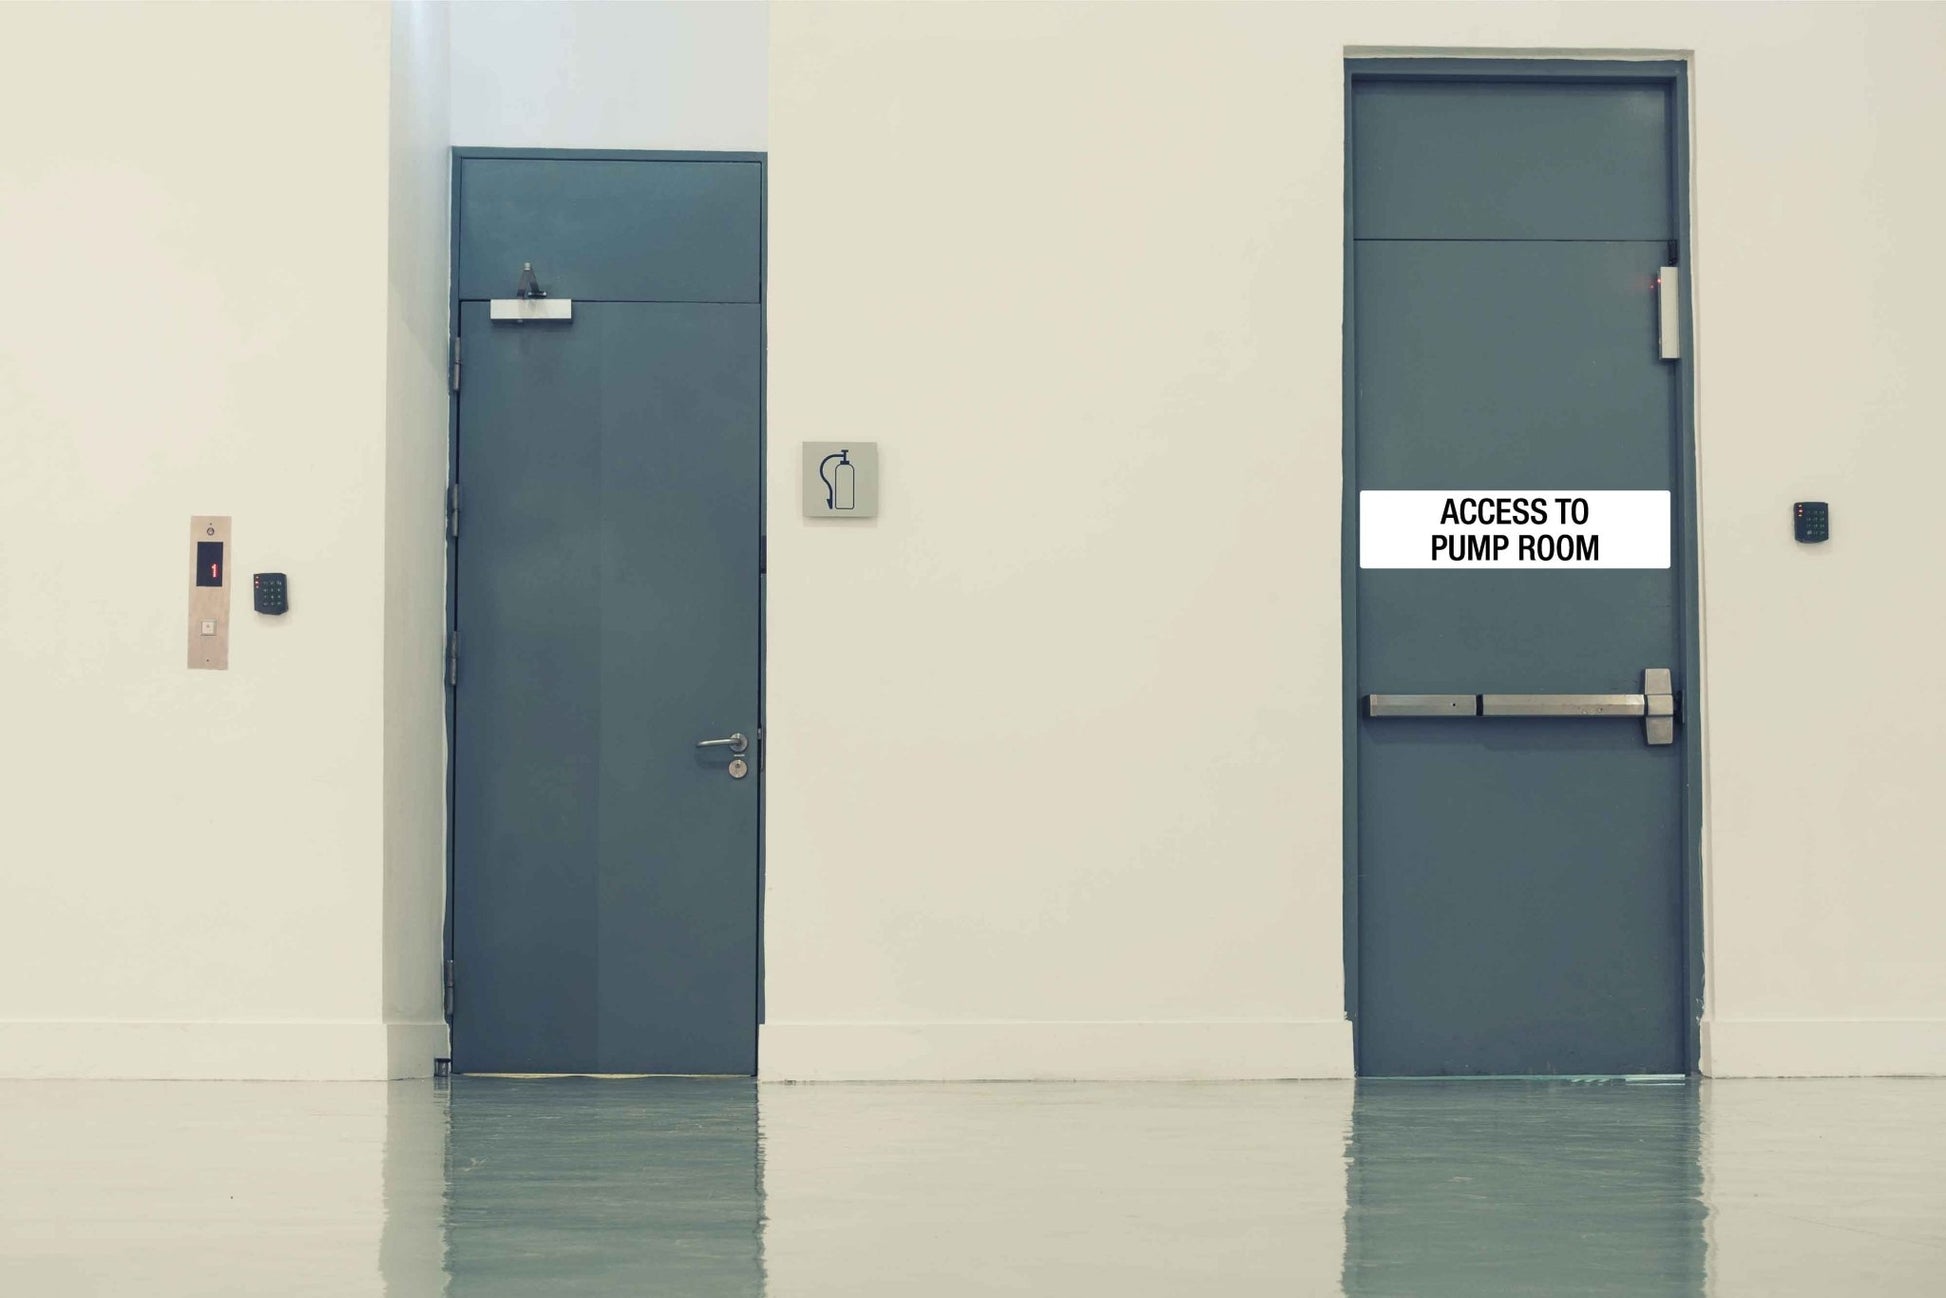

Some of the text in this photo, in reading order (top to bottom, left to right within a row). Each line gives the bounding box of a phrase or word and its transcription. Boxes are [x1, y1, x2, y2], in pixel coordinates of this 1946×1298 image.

[1440, 497, 1589, 525] ACCESS TO
[1431, 534, 1599, 562] PUMP ROOM
[210, 563, 218, 578] 1
